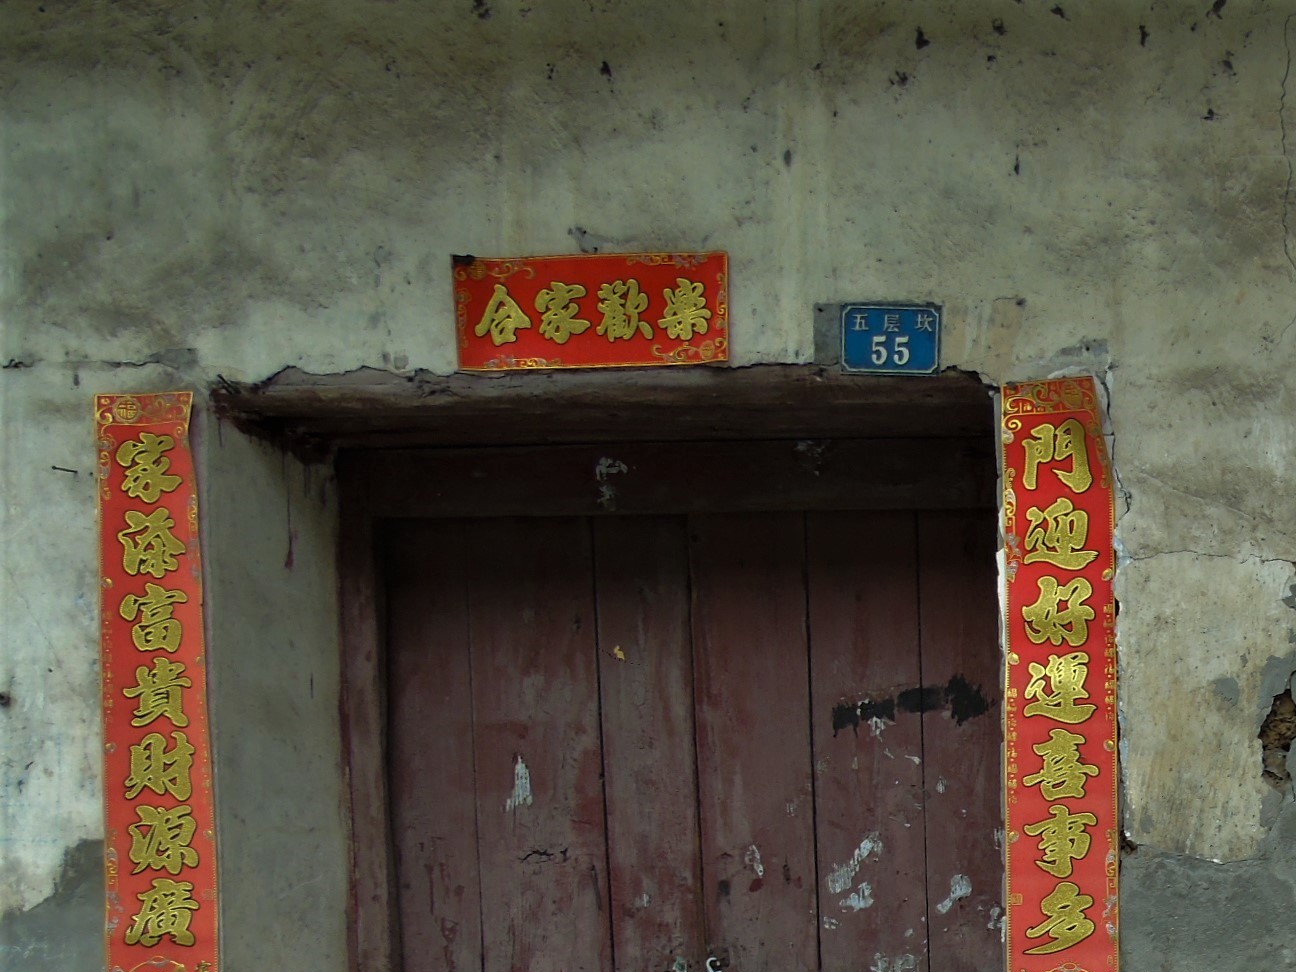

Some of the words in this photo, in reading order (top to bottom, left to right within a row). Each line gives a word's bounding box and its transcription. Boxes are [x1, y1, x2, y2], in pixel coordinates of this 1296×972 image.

[474, 277, 713, 347] 合家歡樂
[851, 313, 934, 332] 五层坎
[871, 335, 910, 365] 55
[115, 431, 200, 947] 家添富貴財源廣
[1022, 418, 1100, 955] 門迎好運喜事多
